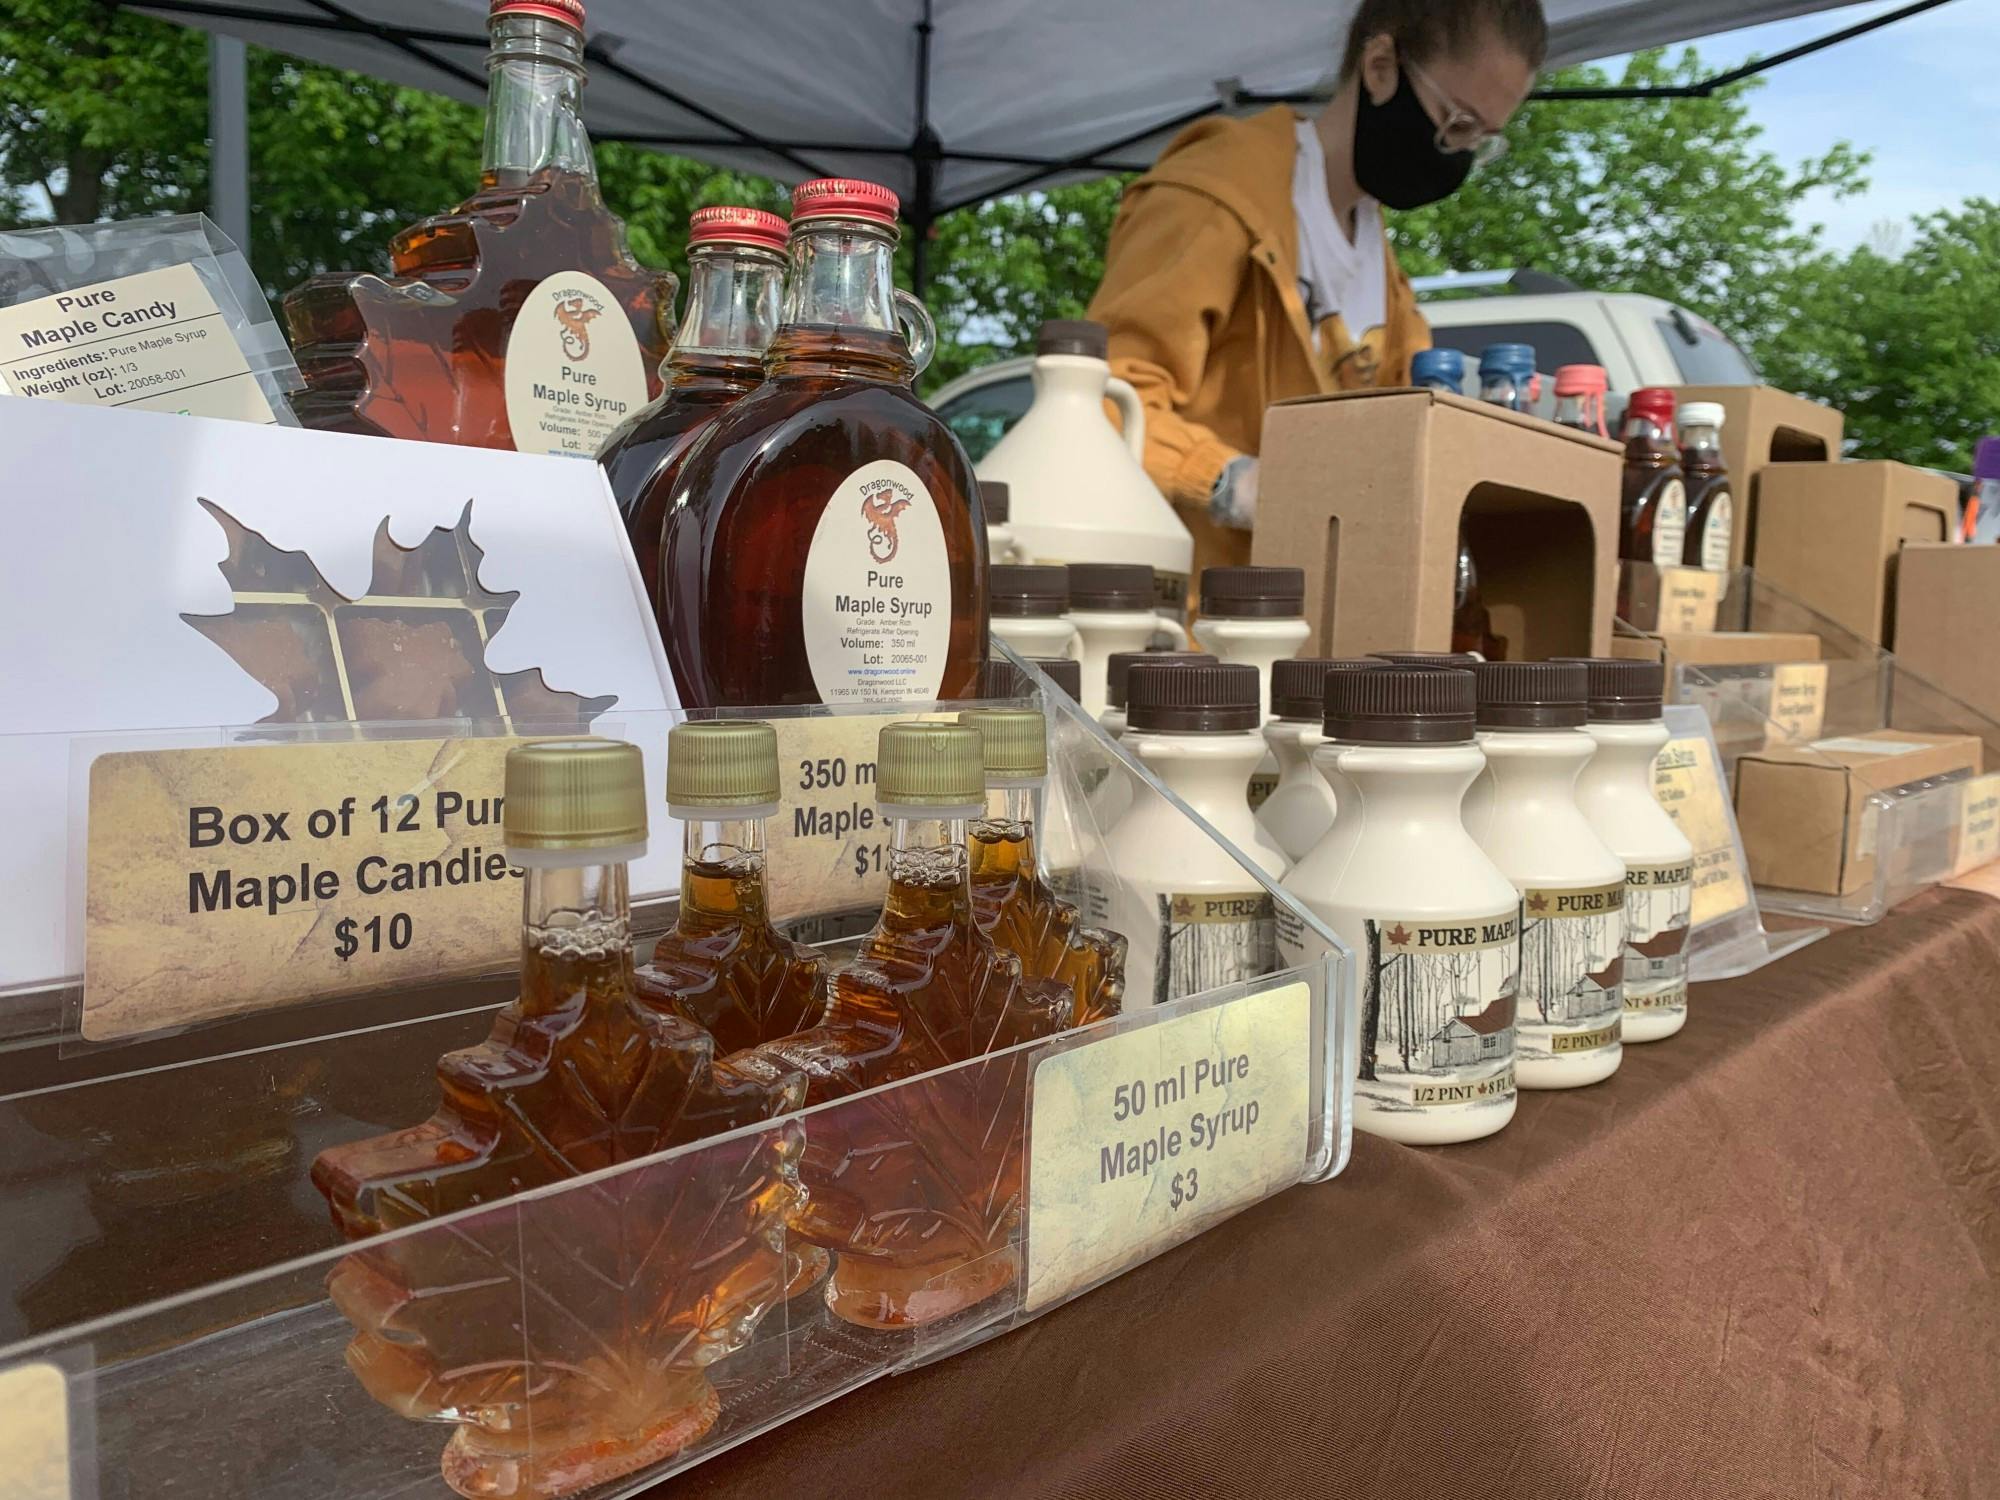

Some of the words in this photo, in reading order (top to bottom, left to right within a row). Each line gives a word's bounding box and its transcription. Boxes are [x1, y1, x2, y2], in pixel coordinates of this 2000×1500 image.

[56, 290, 116, 313] Pure
[20, 320, 98, 348] Maple
[102, 301, 177, 328] Candy
[13, 350, 109, 381] Ingredients:
[109, 344, 138, 358] Pure
[139, 337, 173, 353] Maple
[175, 328, 208, 345] Syrup
[21, 374, 81, 398] Weight
[82, 365, 118, 386] (oz):
[120, 362, 138, 375] 1/3
[94, 384, 127, 400] Lot:
[128, 368, 187, 392] 20058-001
[561, 366, 597, 386] Pure
[533, 383, 580, 405] Maple
[584, 392, 628, 415] Syrup
[539, 420, 581, 437] Volume:
[561, 437, 581, 450] Lot:
[859, 478, 915, 500] Dragonwood
[867, 570, 904, 589] Pure
[835, 595, 885, 617] Maple
[890, 597, 933, 618] Syrup
[840, 637, 884, 648] Volume:
[890, 638, 906, 648] 350
[906, 638, 916, 648] ml
[863, 653, 884, 665] Lot:
[857, 678, 895, 687] Dragonwood
[895, 678, 907, 686] LLC
[799, 758, 847, 791] 350
[855, 761, 877, 785] m
[188, 805, 291, 848] Box
[306, 797, 356, 840] of
[370, 794, 421, 835] 12
[436, 790, 504, 828] Pur
[794, 802, 874, 841] Maple
[855, 844, 889, 878] $1
[188, 862, 340, 916] Maple
[1625, 871, 1649, 885] RE
[1205, 899, 1257, 918] PURE
[1557, 893, 1605, 912] PURE
[334, 912, 413, 962] $10
[1418, 927, 1477, 947] PURE
[1552, 1036, 1569, 1049] 1/2
[1572, 1033, 1601, 1048] PINT
[1113, 1080, 1146, 1122] 50
[1154, 1065, 1186, 1109] ml
[1195, 1054, 1249, 1095] Pure
[1414, 1086, 1434, 1102] 1/2
[1439, 1084, 1475, 1101] PINT
[1100, 1126, 1182, 1184] Maple
[1190, 1100, 1260, 1151] Syrup
[1170, 1167, 1199, 1212] $3
